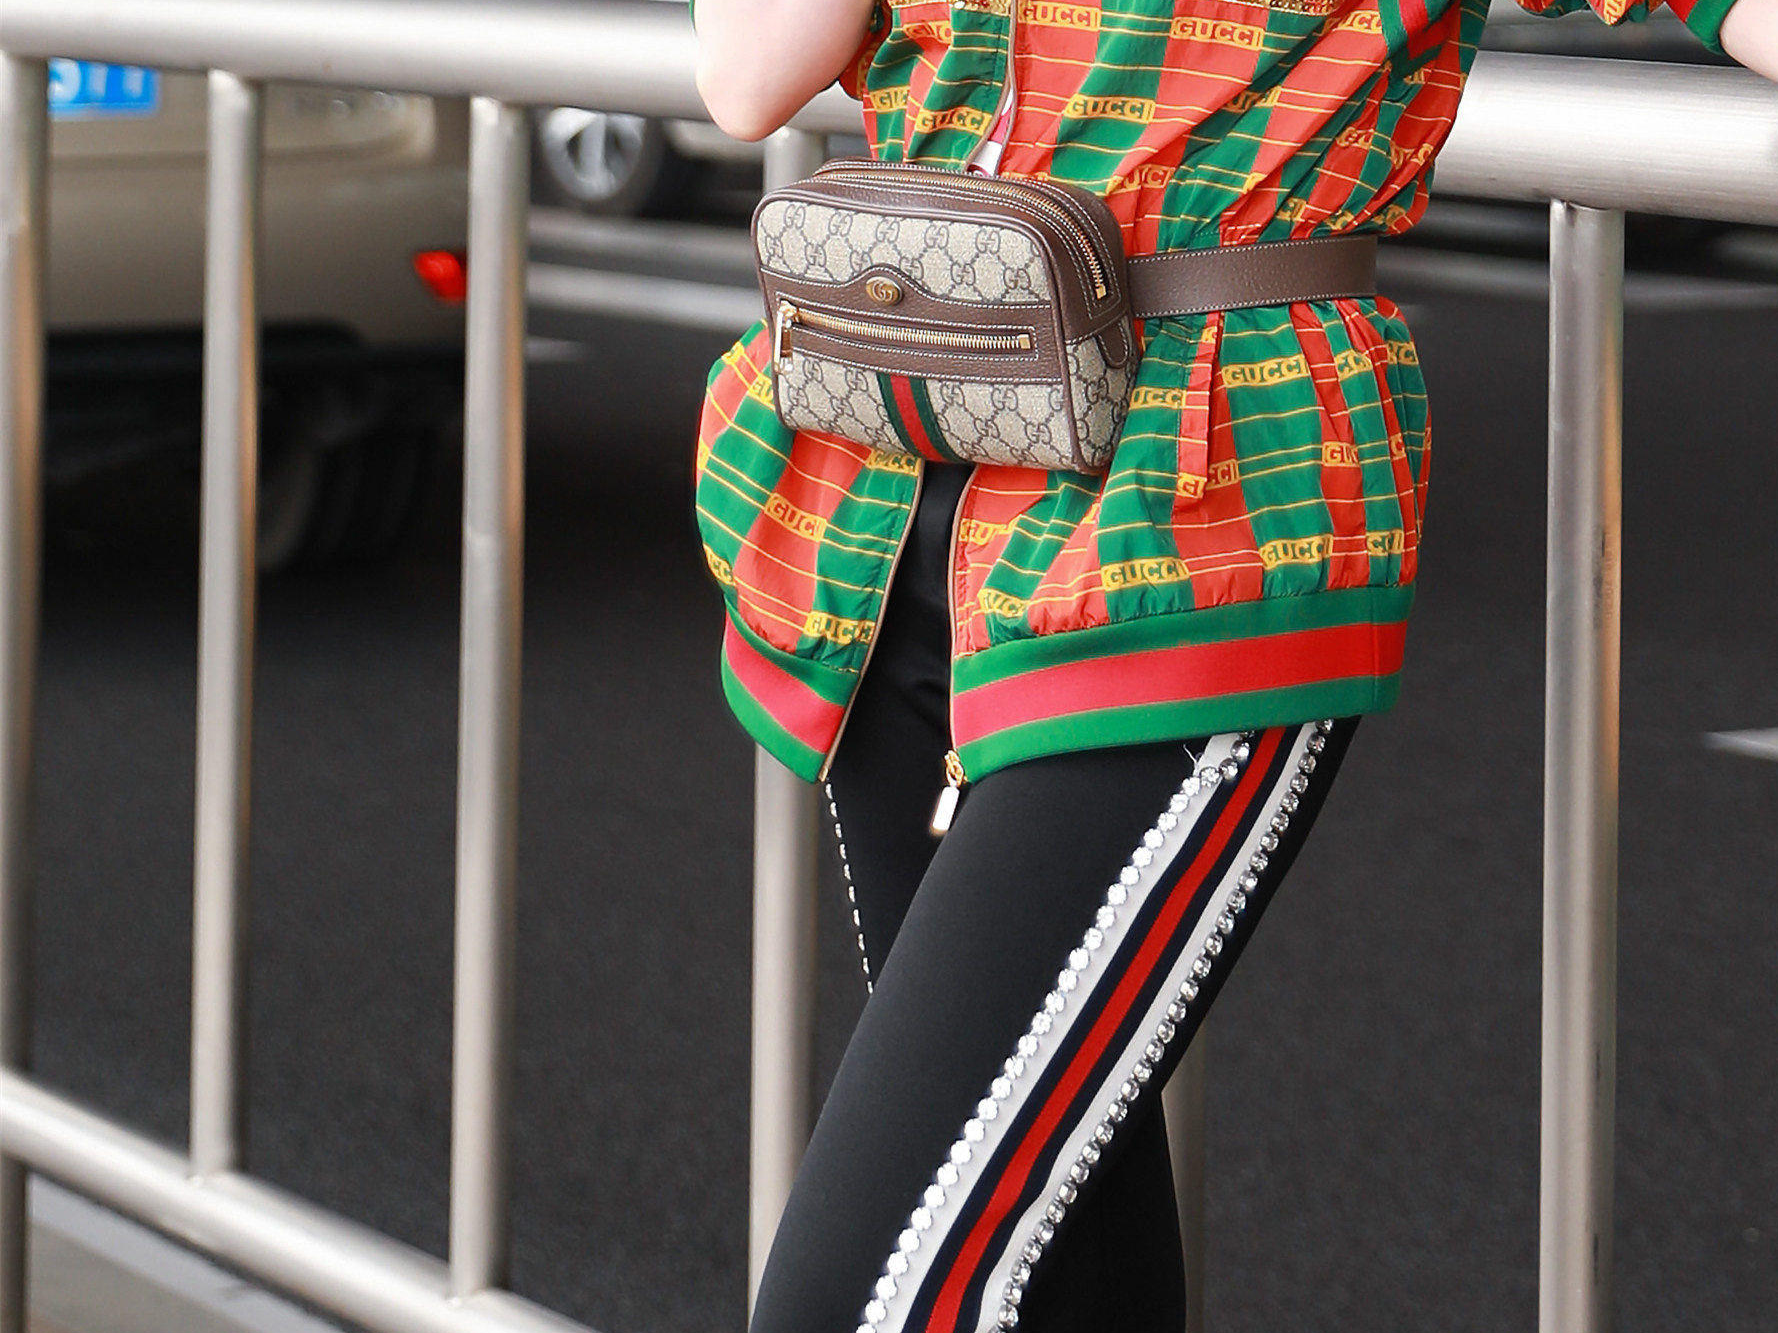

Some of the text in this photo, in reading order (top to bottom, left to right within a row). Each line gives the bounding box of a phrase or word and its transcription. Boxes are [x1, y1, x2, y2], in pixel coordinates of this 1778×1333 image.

[1019, 2, 1099, 30] GUCCI
[1175, 19, 1263, 49] GUCCI
[918, 111, 990, 134] GUCCI
[1068, 97, 1155, 122] GUCCI
[1225, 356, 1309, 385] GUCCI
[1262, 537, 1333, 567] GUCCI
[1104, 562, 1190, 589] GUCCI
